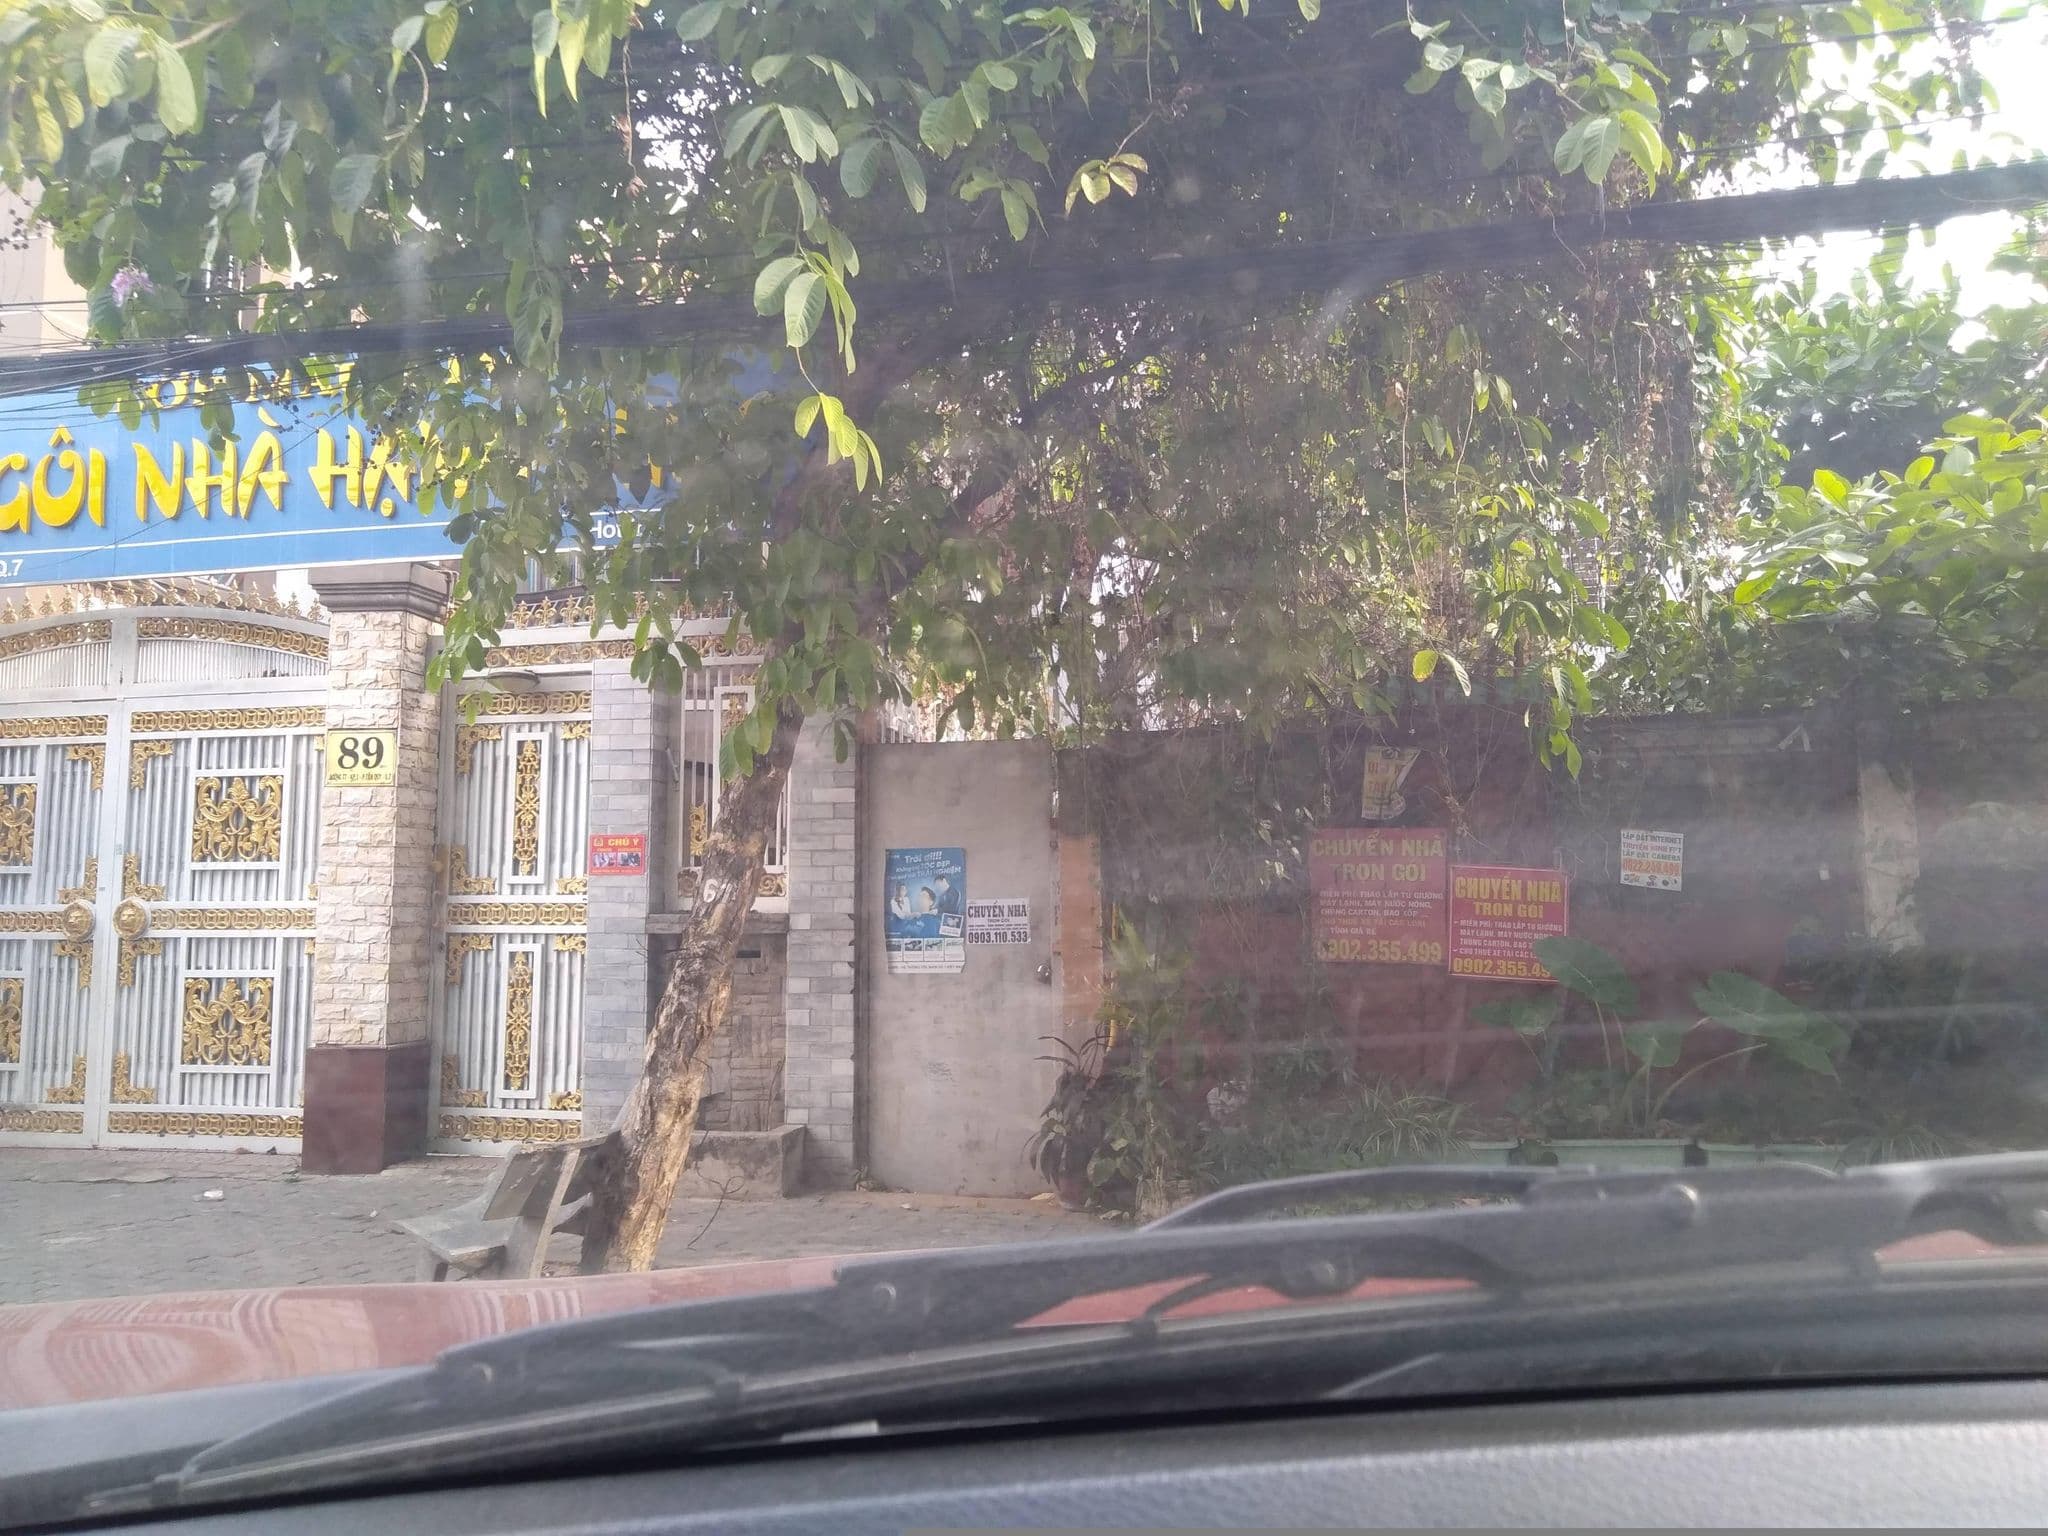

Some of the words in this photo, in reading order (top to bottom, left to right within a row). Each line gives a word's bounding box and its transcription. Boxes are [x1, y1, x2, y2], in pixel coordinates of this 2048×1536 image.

[132, 405, 289, 524] NHÀ
[337, 736, 384, 769] 89
[968, 931, 1028, 944] 0903.110.533
